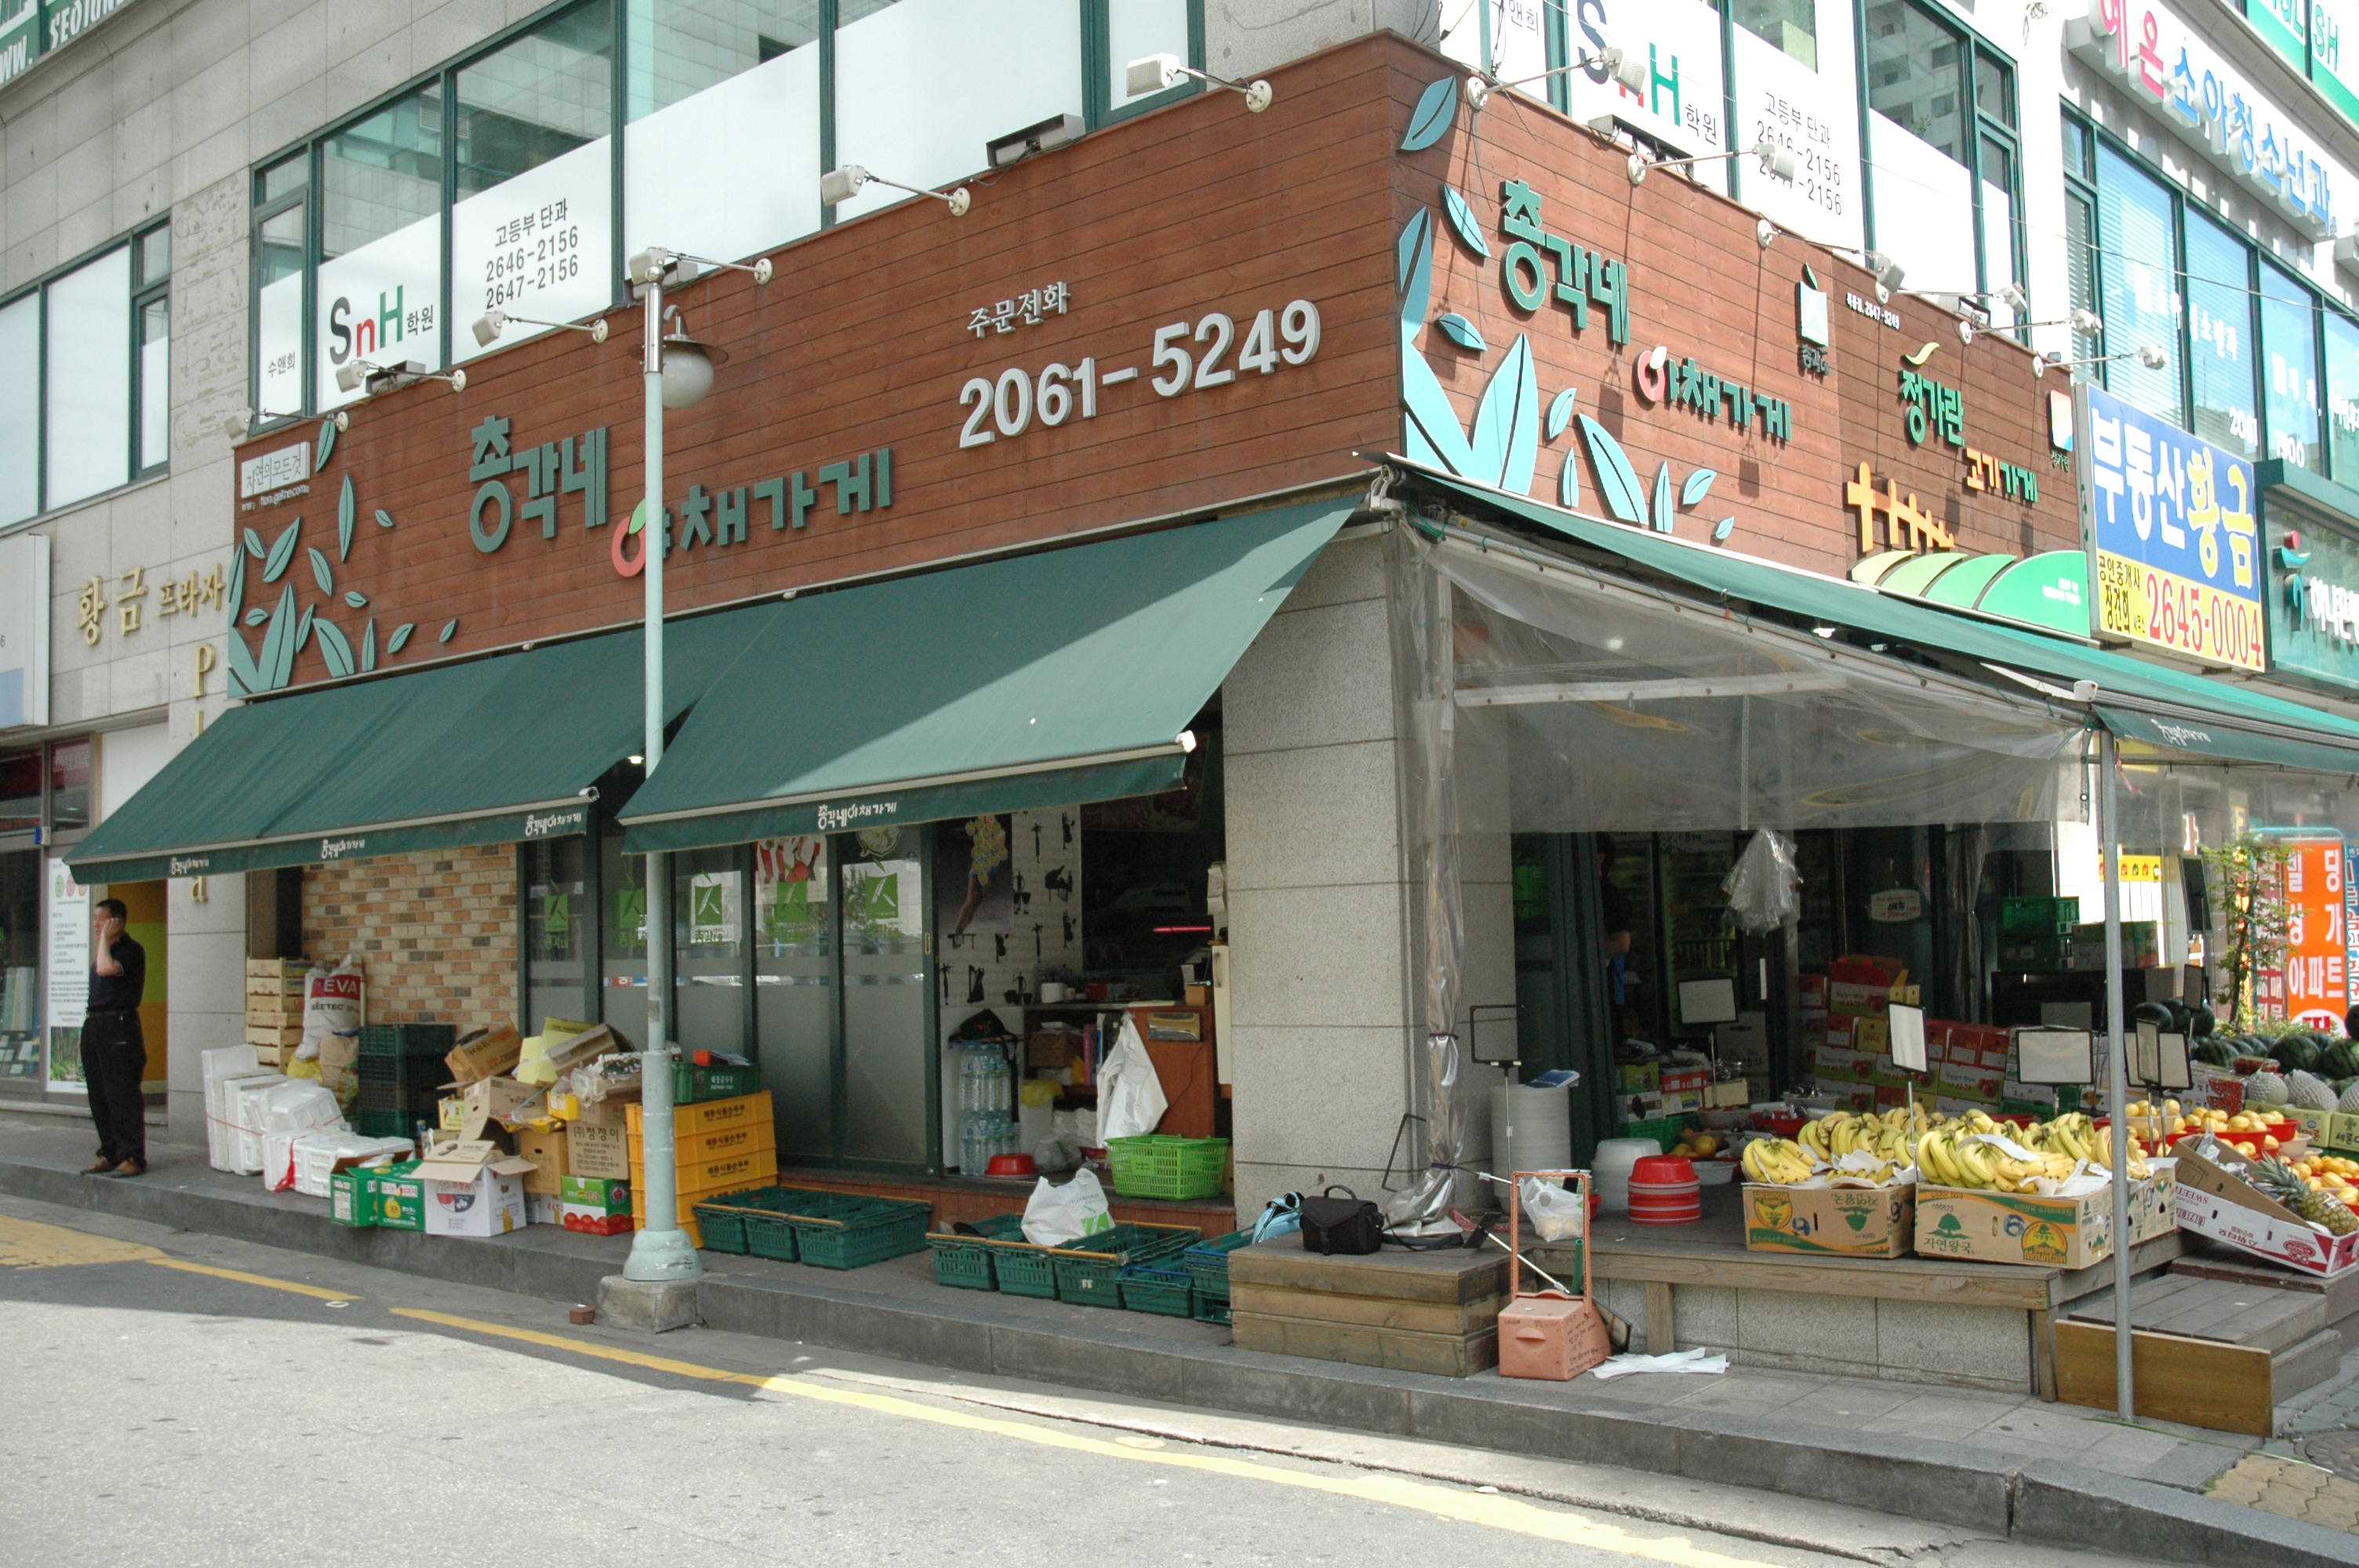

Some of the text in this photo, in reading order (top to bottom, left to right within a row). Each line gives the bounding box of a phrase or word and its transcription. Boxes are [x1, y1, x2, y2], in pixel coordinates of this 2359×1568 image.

[1685, 103, 1717, 146] 학원
[1765, 92, 1830, 147] 고등부 단과
[493, 198, 569, 248] 고등부 단과
[485, 227, 579, 282] 2646-2156
[1502, 179, 1630, 345] 총각네
[485, 257, 579, 310] 2647-2156
[967, 280, 1071, 338] 주문전화
[329, 285, 435, 365] SnH 학원
[959, 299, 1321, 448] 2061-5249
[1637, 346, 1793, 442] 야채가게
[470, 415, 610, 553] 총각네
[1966, 447, 2038, 503] 고기가게
[2092, 408, 2255, 590] 부동산 황금
[2099, 555, 2141, 591] 공인중개사
[76, 562, 226, 647] 황금 프라자
[2146, 573, 2262, 667] 2645-0004
[324, 979, 358, 996] EVA
[2288, 955, 2344, 1000] 아파트
[1923, 1236, 1973, 1254] 자연왕국
